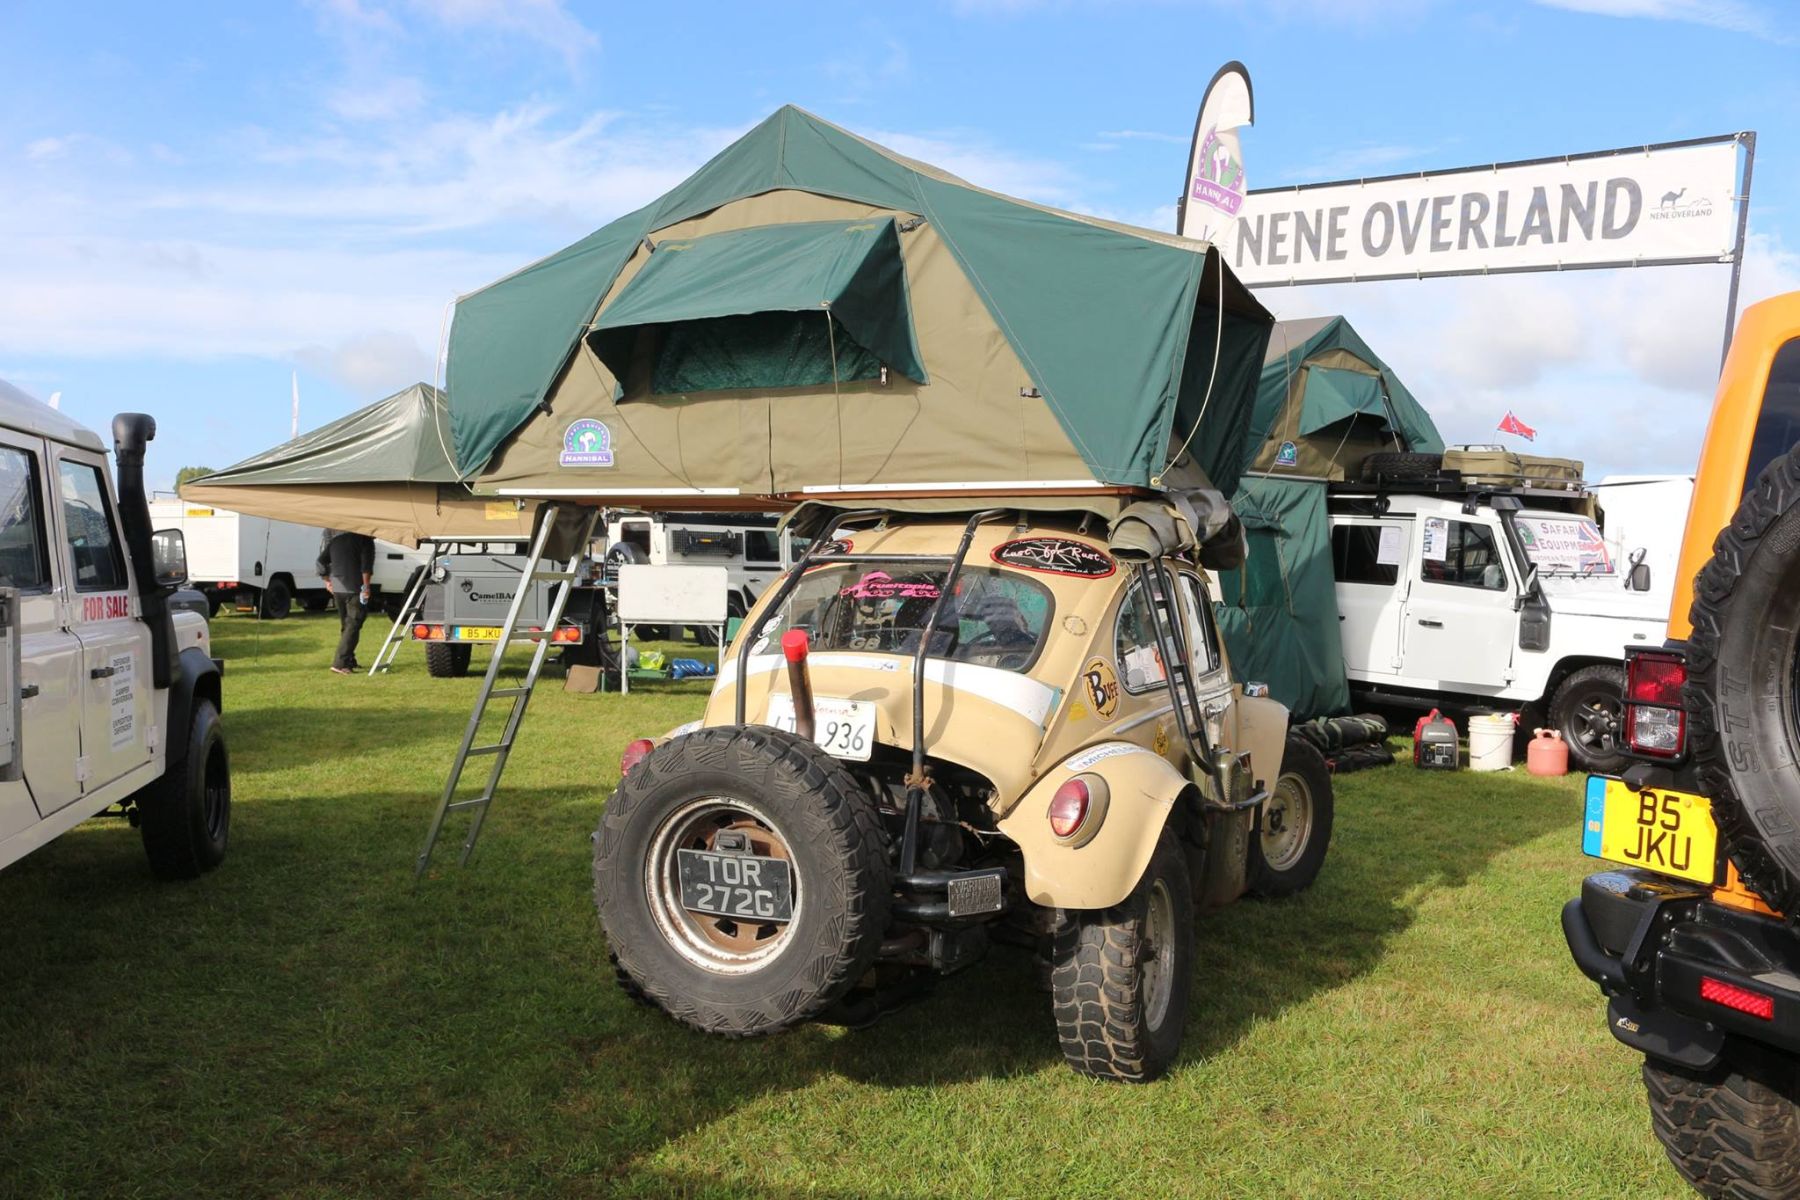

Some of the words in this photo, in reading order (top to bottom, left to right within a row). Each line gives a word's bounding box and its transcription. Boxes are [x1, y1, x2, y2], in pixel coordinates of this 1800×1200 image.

[1236, 205, 1350, 268] NENE
[1361, 176, 1643, 258] OVERLAND
[1650, 211, 1670, 220] NENE
[1671, 208, 1712, 219] OVERLAND
[564, 455, 609, 463] HANNIBAL
[1540, 522, 1579, 536] SAFARI
[84, 597, 104, 622] FOR
[106, 595, 129, 619] SALE
[483, 628, 500, 639] JKU
[1637, 790, 1680, 832] B5
[1623, 826, 1691, 871] JKU
[702, 855, 762, 887] TOR
[696, 883, 775, 917] 272G
